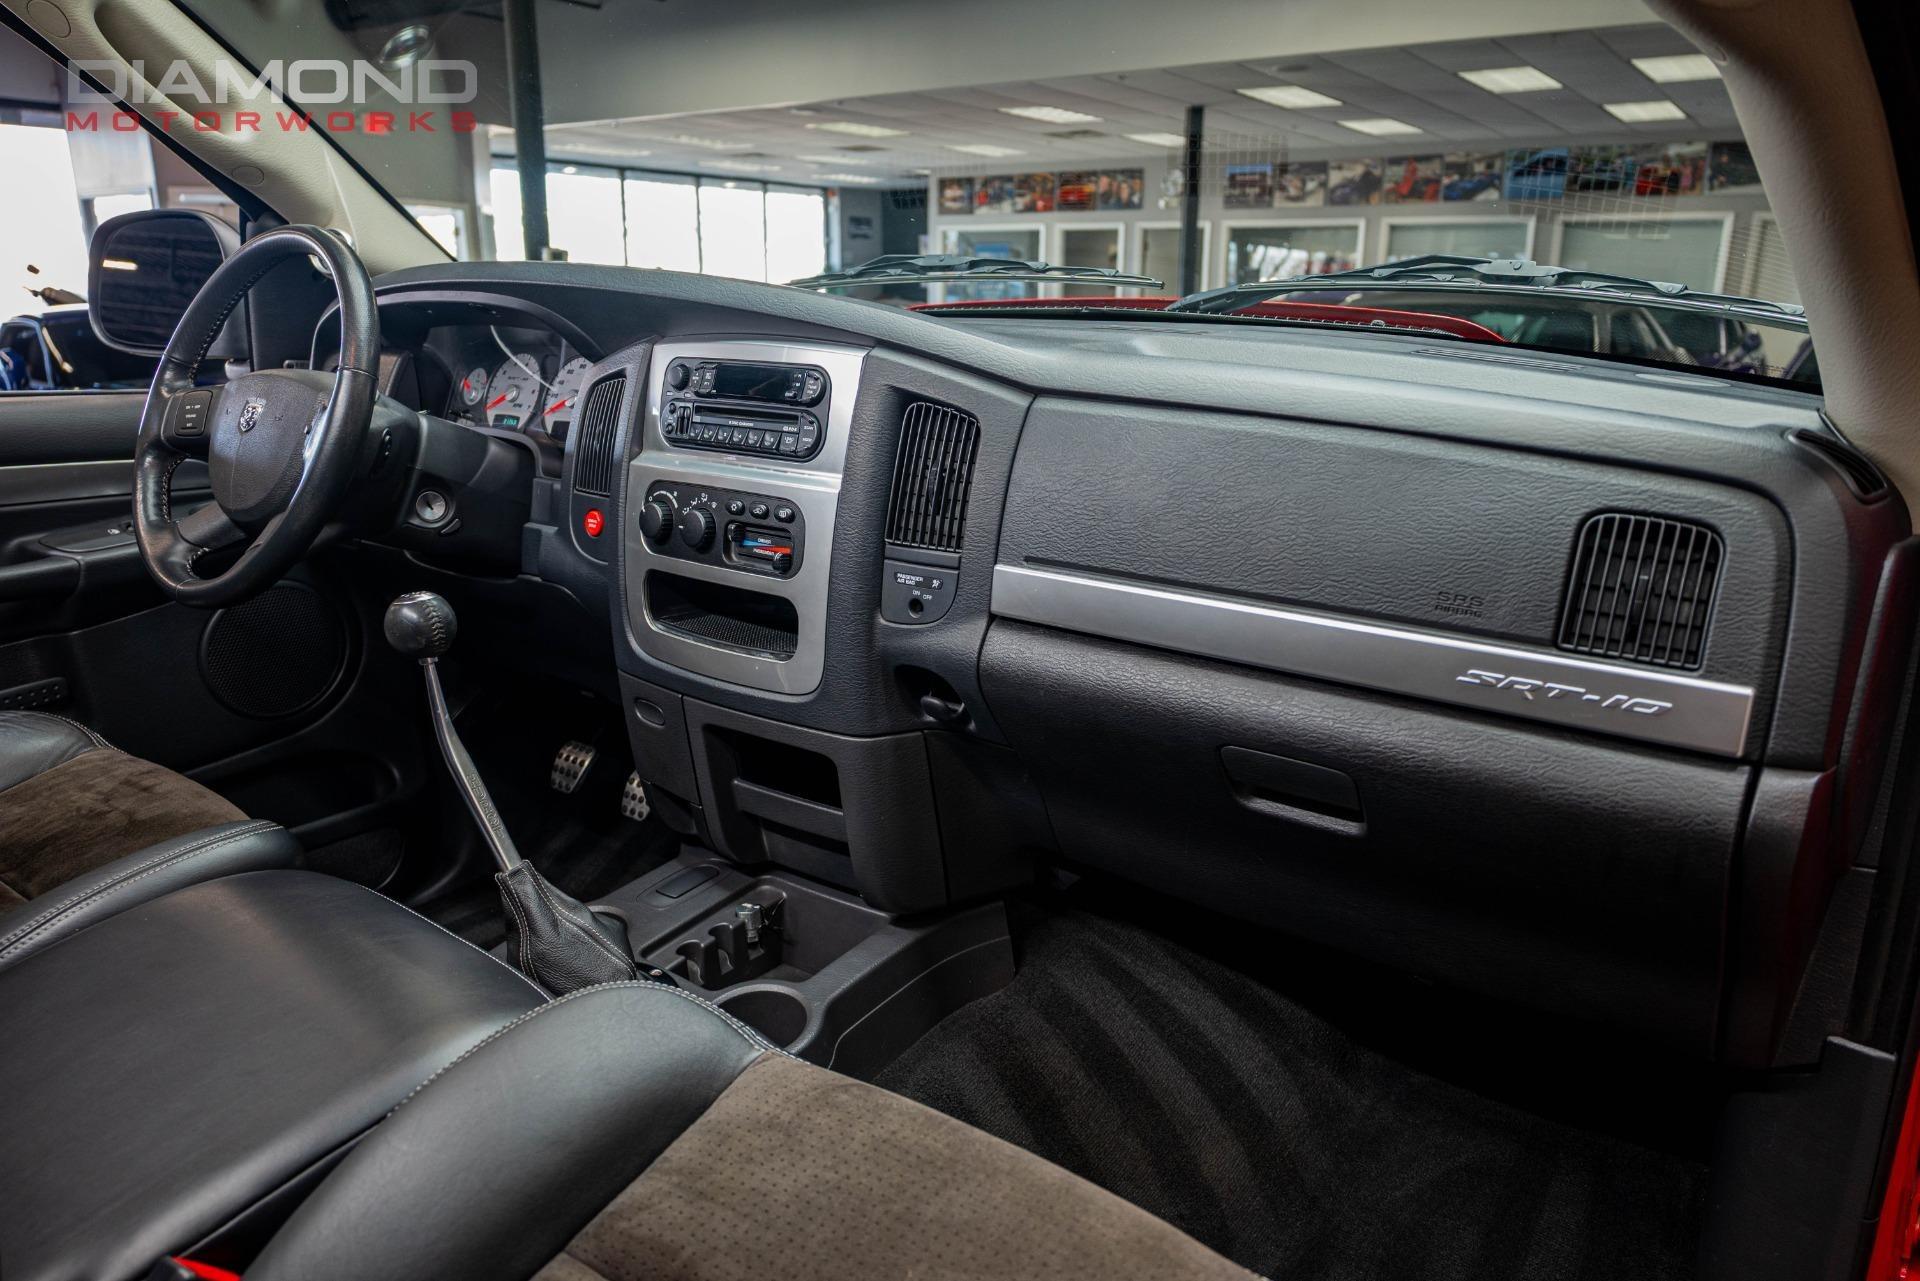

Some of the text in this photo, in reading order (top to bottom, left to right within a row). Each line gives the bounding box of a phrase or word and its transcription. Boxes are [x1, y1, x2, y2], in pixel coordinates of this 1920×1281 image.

[896, 572, 924, 582] PASSENGER
[1437, 591, 1483, 607] SRS
[1434, 604, 1482, 618] AIRBAG
[1455, 669, 1673, 714] SRT-10
